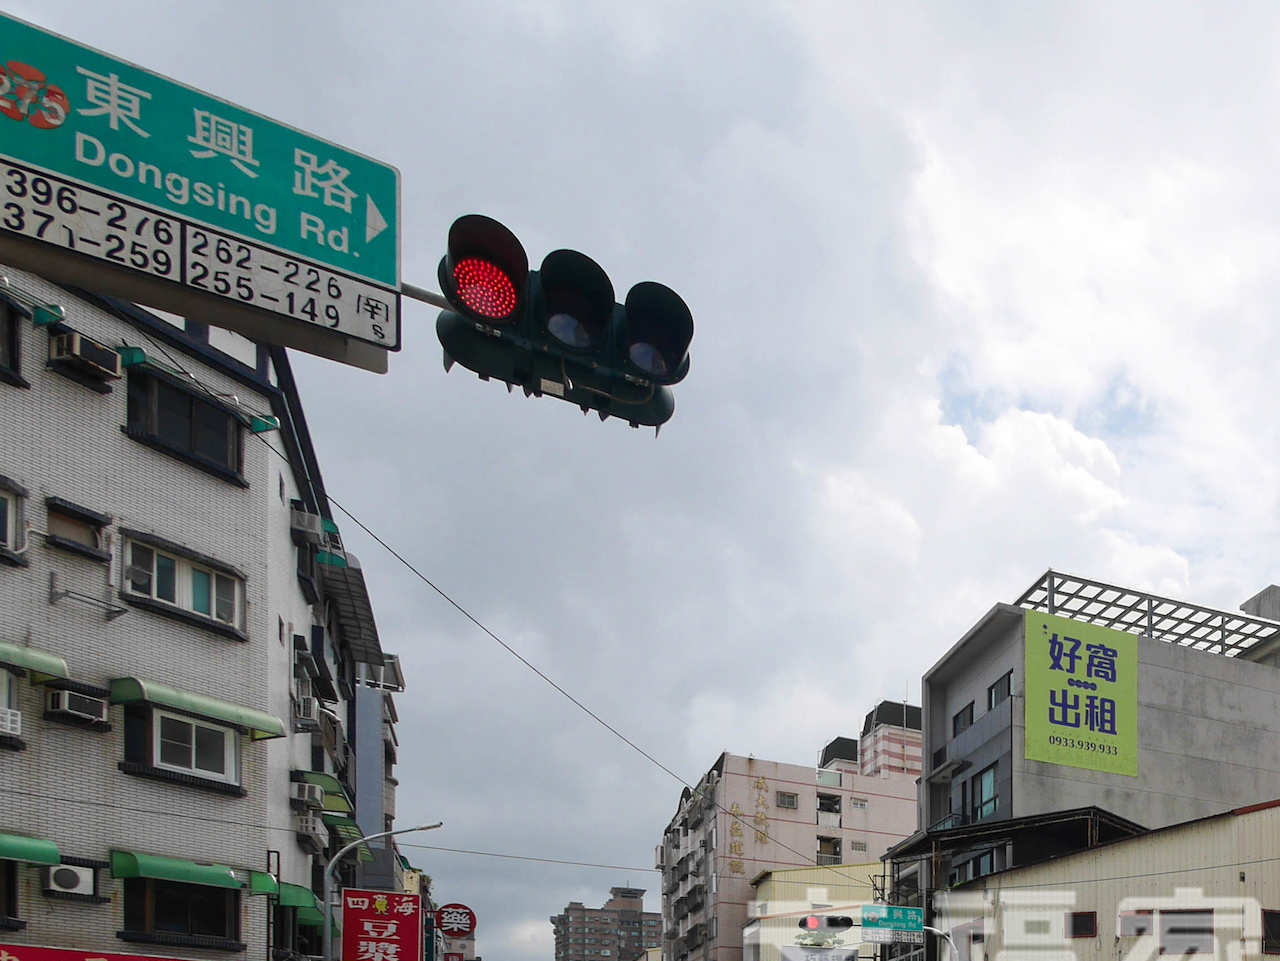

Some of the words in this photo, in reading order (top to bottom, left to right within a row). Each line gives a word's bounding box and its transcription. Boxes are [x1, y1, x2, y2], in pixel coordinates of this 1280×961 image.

[76, 66, 358, 214] 東興路
[5, 168, 173, 246] 396-276
[75, 131, 277, 235] Dongsing
[300, 212, 361, 257] Rd.
[190, 262, 340, 329] 255-149
[192, 231, 342, 300] 262-226
[1049, 633, 1118, 683] 好窩
[1049, 689, 1118, 735] 出租
[347, 894, 418, 916] 四海
[441, 908, 471, 932] 藥
